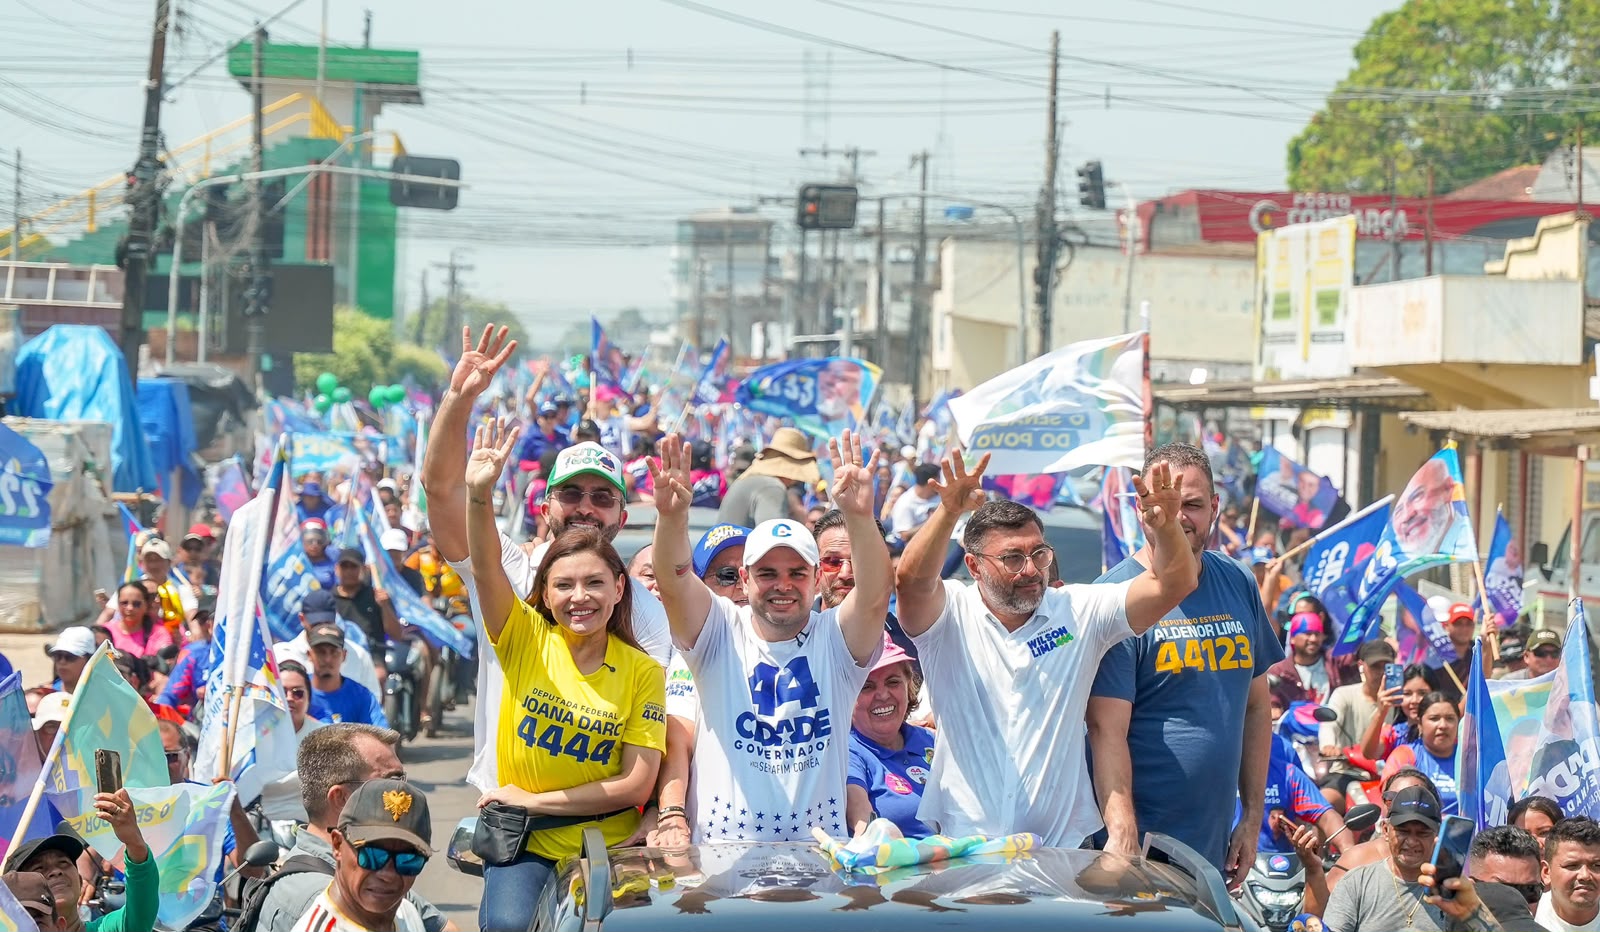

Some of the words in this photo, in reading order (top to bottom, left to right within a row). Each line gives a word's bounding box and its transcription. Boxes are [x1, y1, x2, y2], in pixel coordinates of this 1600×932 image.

[1154, 623, 1215, 642] ALDENOR
[1215, 620, 1246, 635] LIMA
[1159, 617, 1198, 627] DEPUTADO
[1199, 613, 1233, 624] ESTADUAL
[1027, 625, 1068, 650] WILSON
[1031, 640, 1058, 659] LIMA
[1155, 635, 1253, 675] 44123
[748, 655, 820, 717] 44
[522, 695, 575, 727] JOANA
[577, 717, 624, 737] DARC
[532, 687, 579, 710] DEPUTADA
[580, 704, 619, 721] FEDERAL
[517, 714, 616, 766] 4444
[759, 761, 791, 774] SERAFIM
